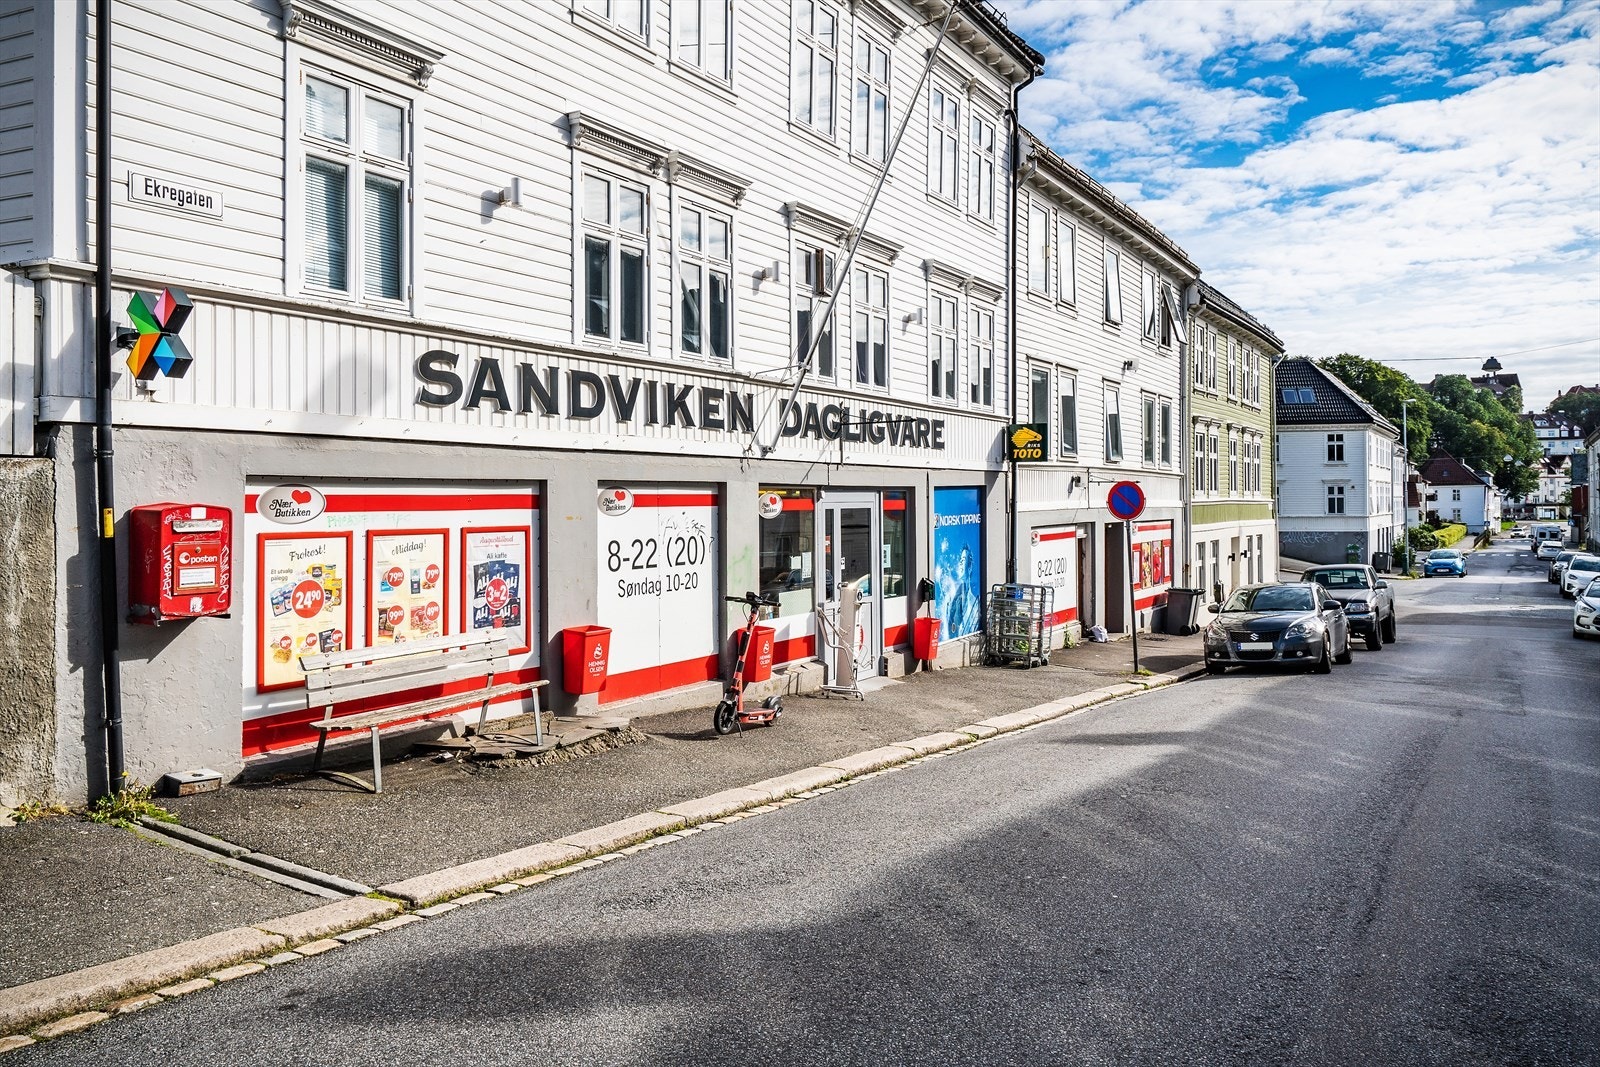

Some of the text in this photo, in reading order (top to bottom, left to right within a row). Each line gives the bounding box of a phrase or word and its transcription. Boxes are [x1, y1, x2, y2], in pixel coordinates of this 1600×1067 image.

[144, 177, 213, 209] Ekregaten
[415, 349, 945, 450] SANDVIKEN DAGLIGVARE
[1013, 448, 1042, 459] TOTO
[269, 498, 293, 511] Nær
[274, 508, 311, 518] Butikken
[940, 513, 982, 527] NORSK TIPPING
[289, 543, 326, 562] Frokost!
[391, 538, 427, 556] Middag!
[607, 535, 706, 573] 8-22 (20)
[190, 554, 218, 565] posten
[1037, 557, 1067, 578] 8-22 (20)
[488, 585, 495, 602] 3
[500, 584, 507, 601] 2
[617, 571, 699, 598] Søndag 10-20
